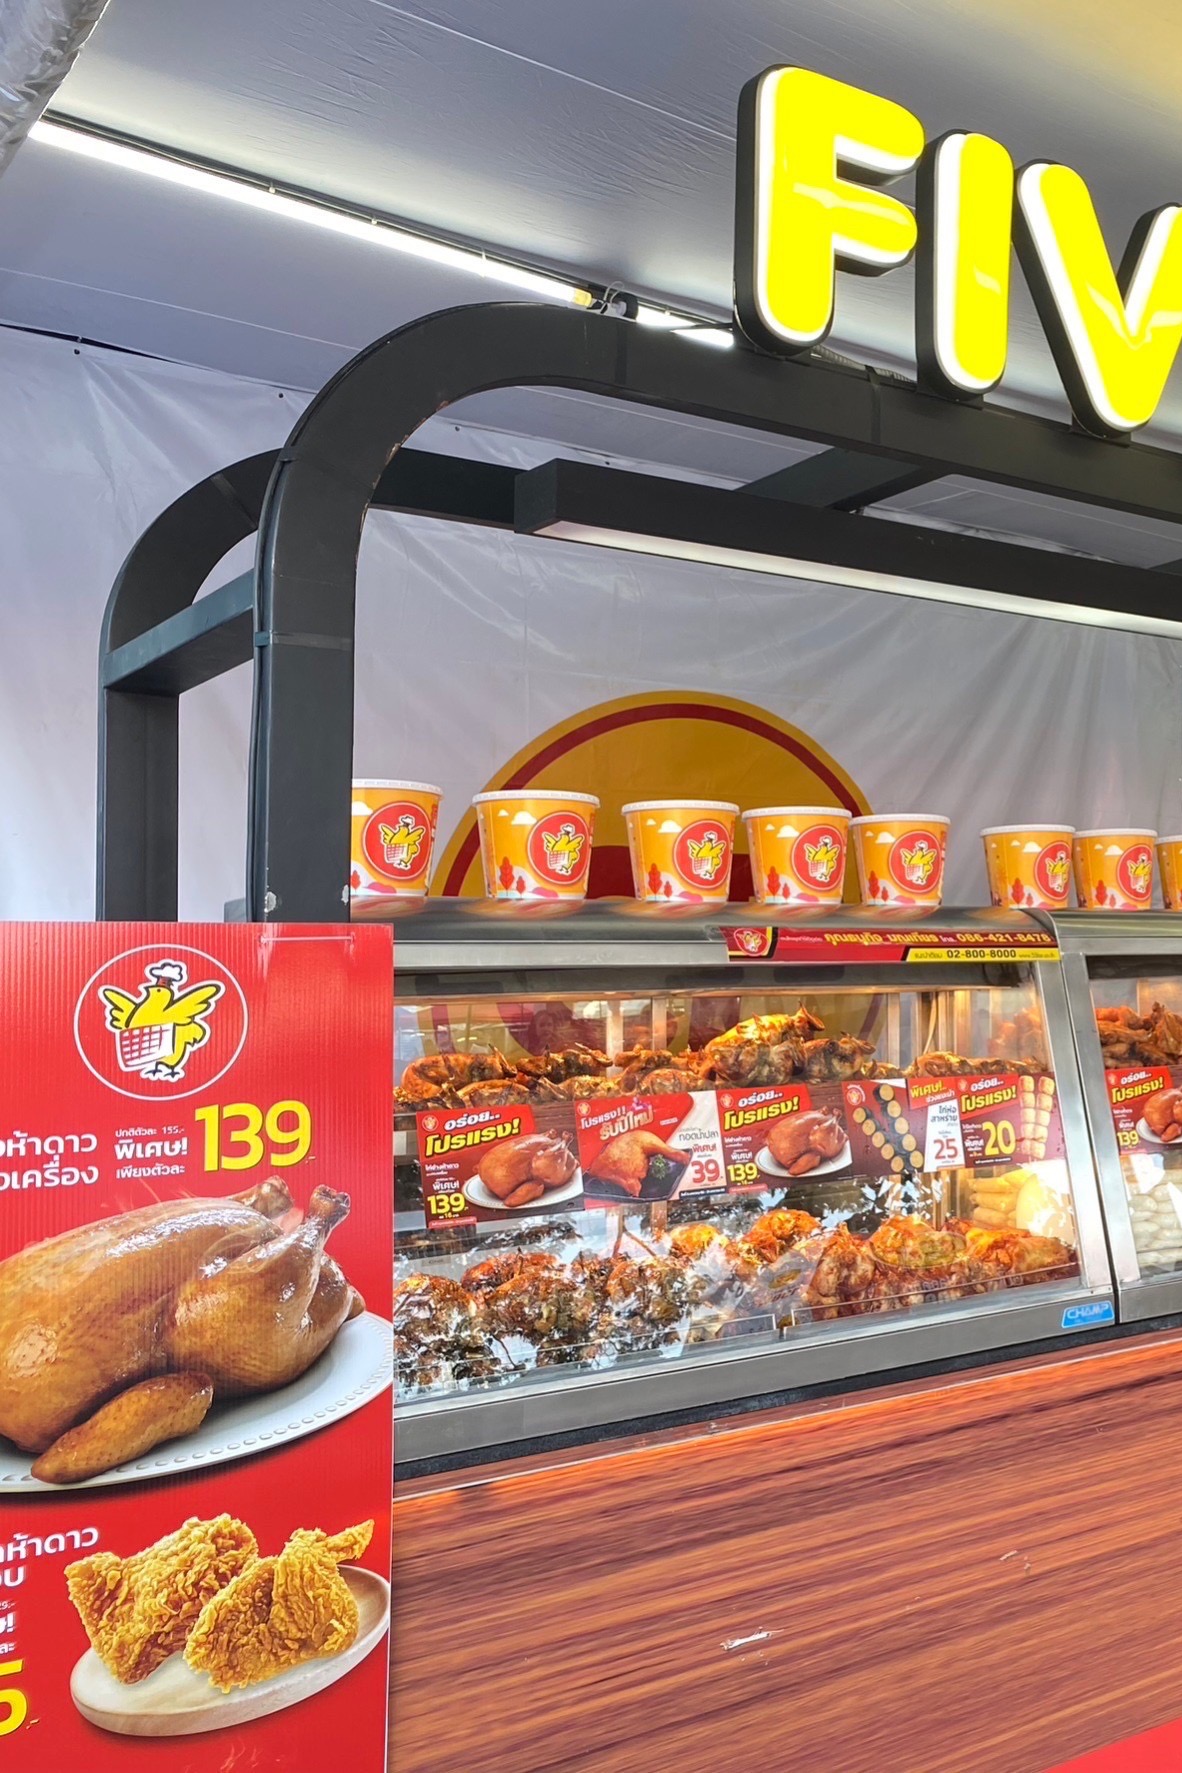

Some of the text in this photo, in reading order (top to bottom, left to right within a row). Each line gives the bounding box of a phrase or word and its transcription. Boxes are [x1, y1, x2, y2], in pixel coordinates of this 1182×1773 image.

[946, 949, 1016, 959] 02-800-8000
[961, 1085, 1017, 1114] โปรแรง!
[1112, 1077, 1164, 1104] โปรแรง!
[723, 1096, 799, 1131] โปรแรง!
[114, 1136, 188, 1160] พิเศษ!
[425, 1118, 520, 1157] โปรแรง!
[933, 1138, 959, 1160] 25
[982, 1119, 1016, 1157] 20
[116, 1162, 185, 1179] เพียงตัวละ
[1066, 1303, 1109, 1319] CHAMP
[0, 1526, 99, 1563] ห้าดาว
